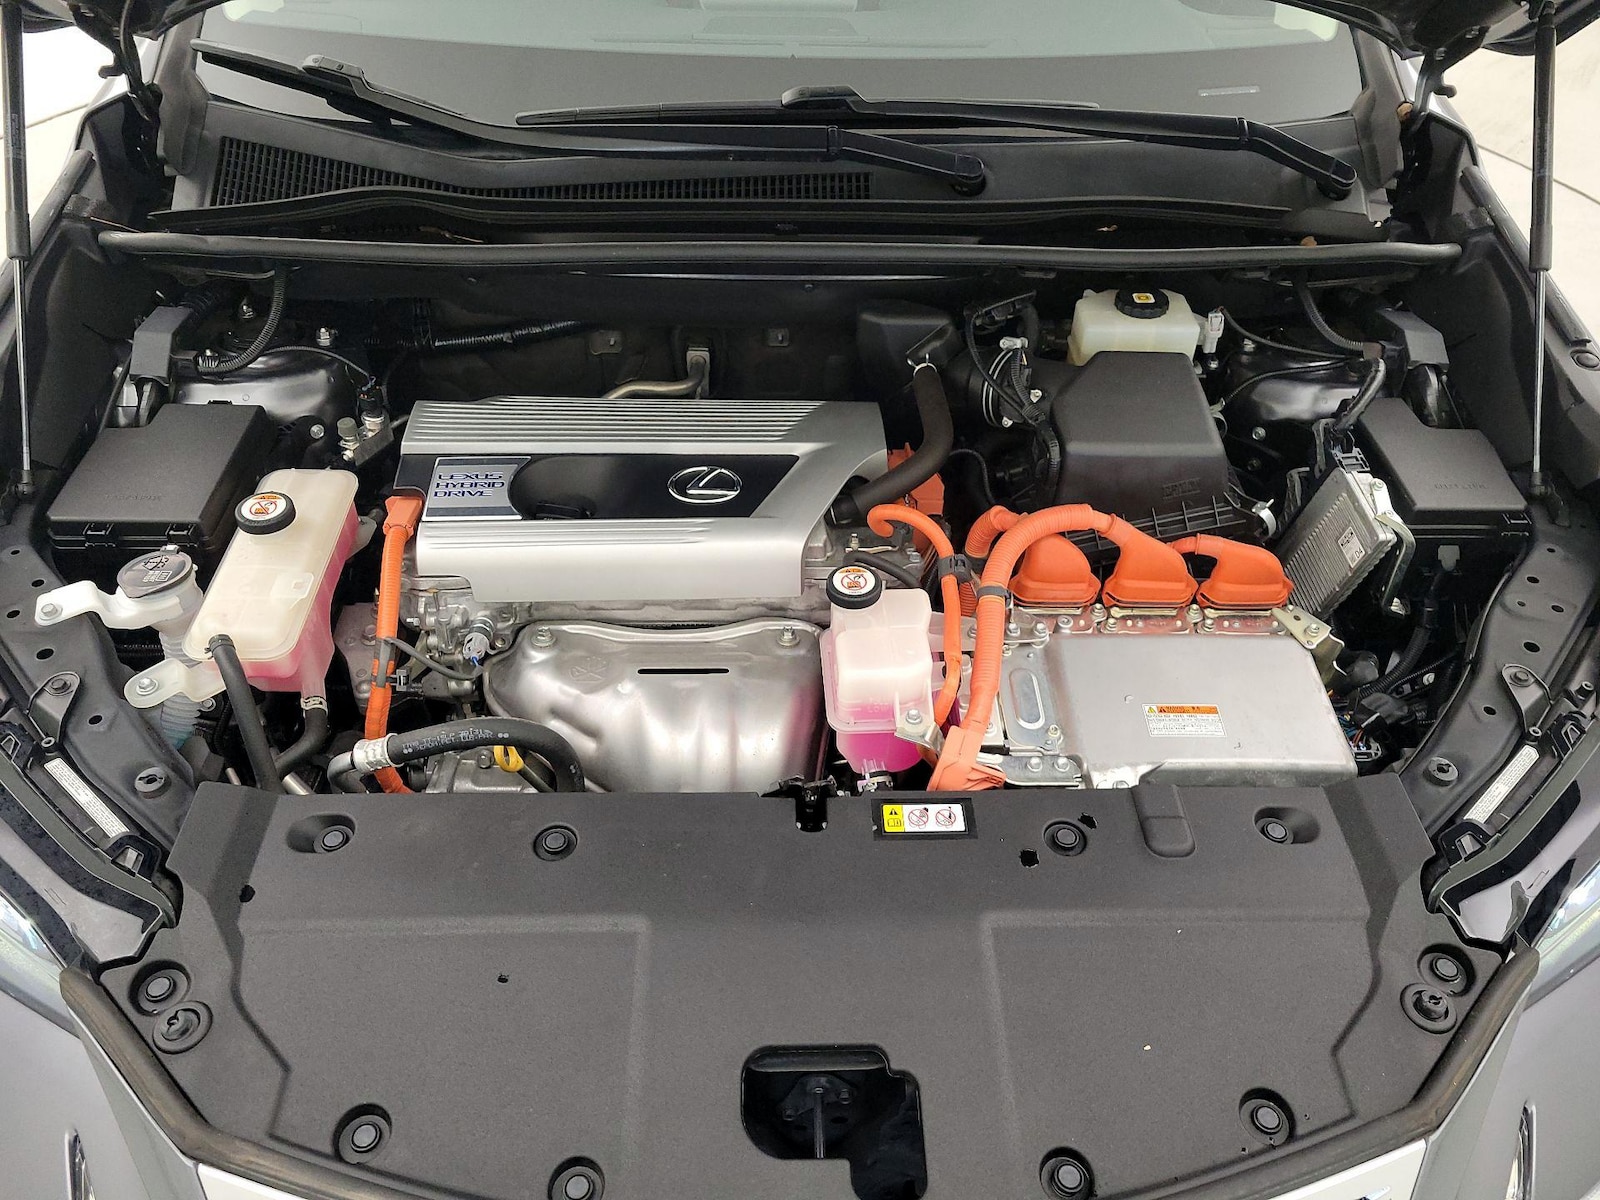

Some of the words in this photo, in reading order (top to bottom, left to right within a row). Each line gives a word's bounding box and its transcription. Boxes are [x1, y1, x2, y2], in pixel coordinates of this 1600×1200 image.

[438, 472, 504, 480] LEXUS
[435, 481, 505, 489] HYBRID
[433, 489, 493, 497] DRIVE
